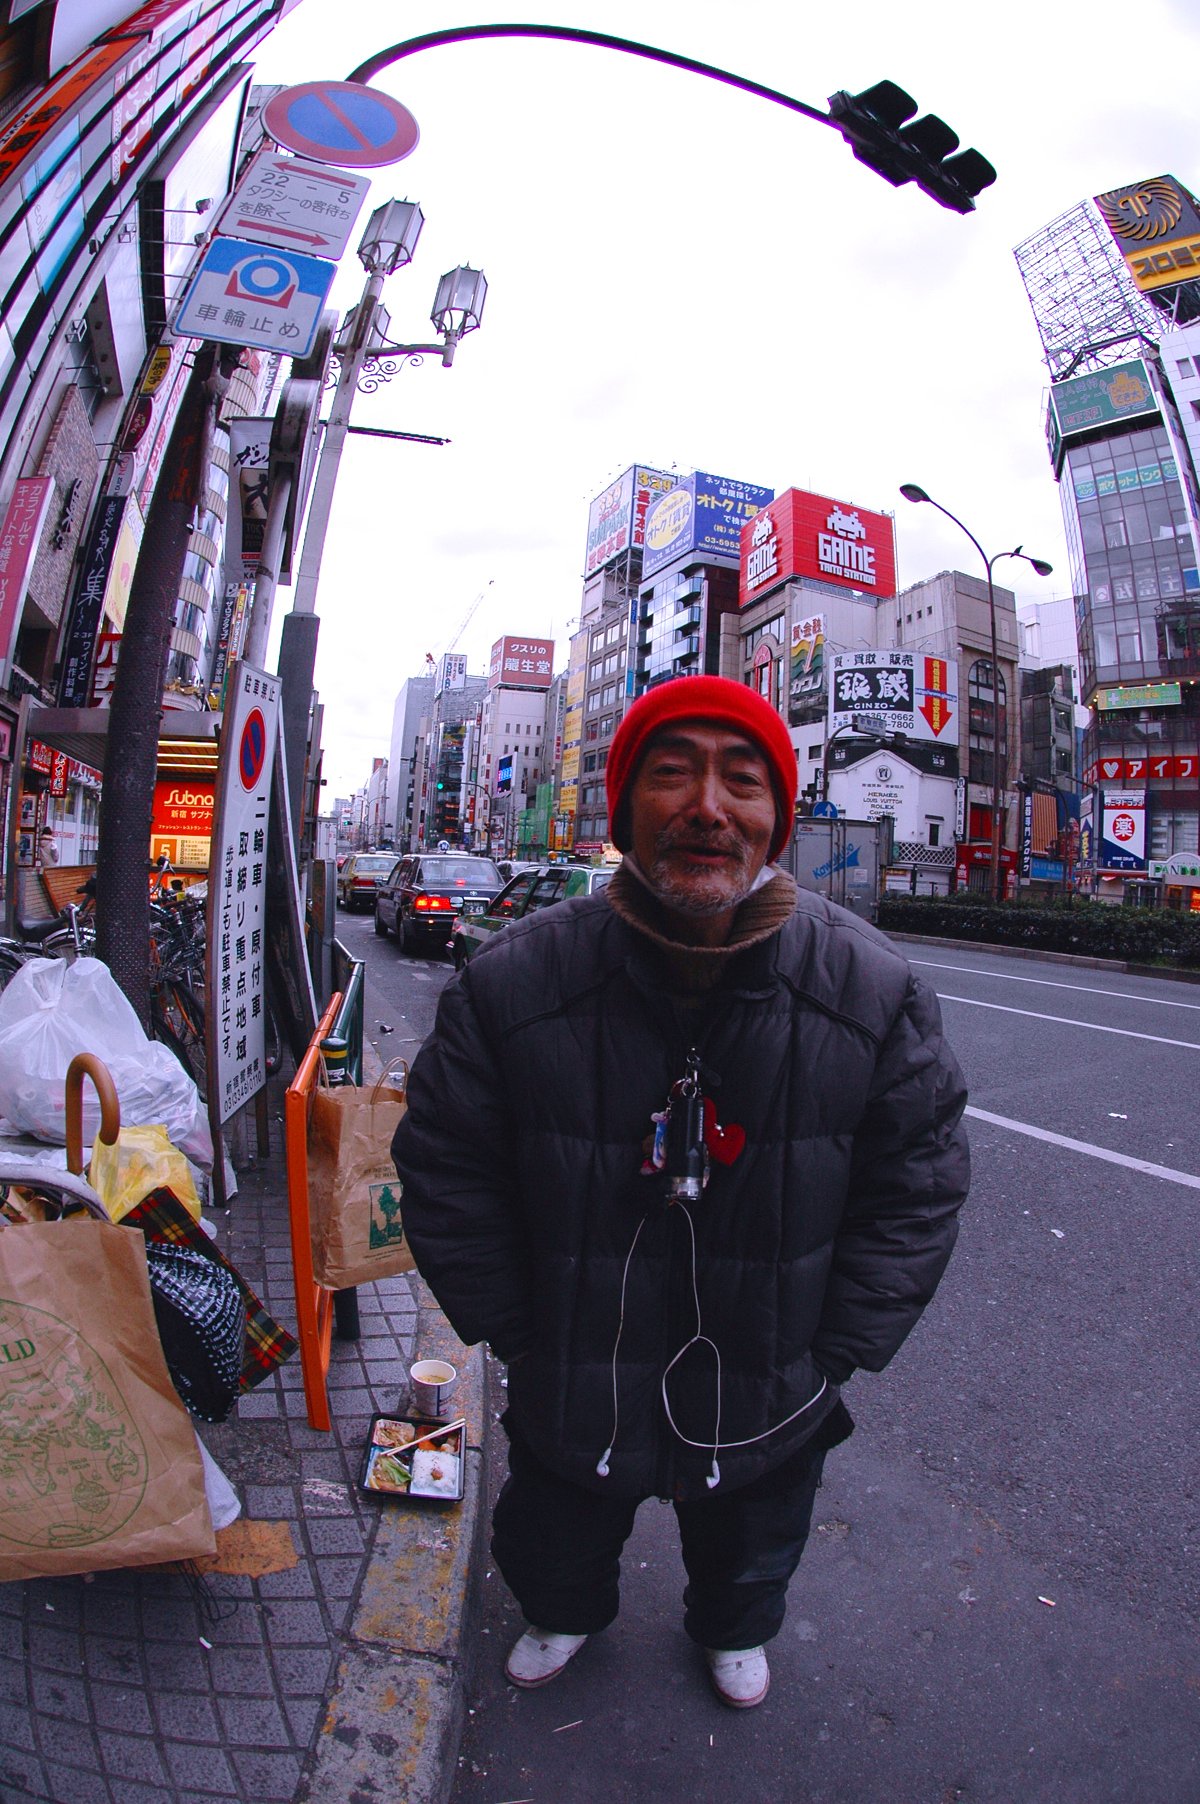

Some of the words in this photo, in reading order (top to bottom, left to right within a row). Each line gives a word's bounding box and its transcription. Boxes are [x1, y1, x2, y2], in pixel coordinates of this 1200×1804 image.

[261, 173, 290, 188] 22
[338, 191, 351, 204] 5
[238, 201, 291, 221] を除く
[247, 185, 351, 221] タクシーの客待ち
[195, 304, 300, 338] 車輪止め
[705, 476, 766, 496] ネットでラクラク
[18, 485, 43, 546] カラフルで
[747, 536, 778, 582] GAME
[818, 532, 876, 575] GAME
[844, 567, 876, 586] STATION
[510, 643, 546, 655] クスリの
[503, 658, 551, 675] 龍生堂
[837, 670, 910, 703] 銀蔵
[1129, 760, 1192, 778] アイフ
[164, 789, 214, 806] Subna
[171, 810, 187, 819] 新宿
[190, 811, 213, 820] サブナ
[1116, 817, 1133, 838] 薬
[160, 843, 171, 860] 5
[1154, 864, 1200, 877] PANDO
[0, 1337, 36, 1365] LD
